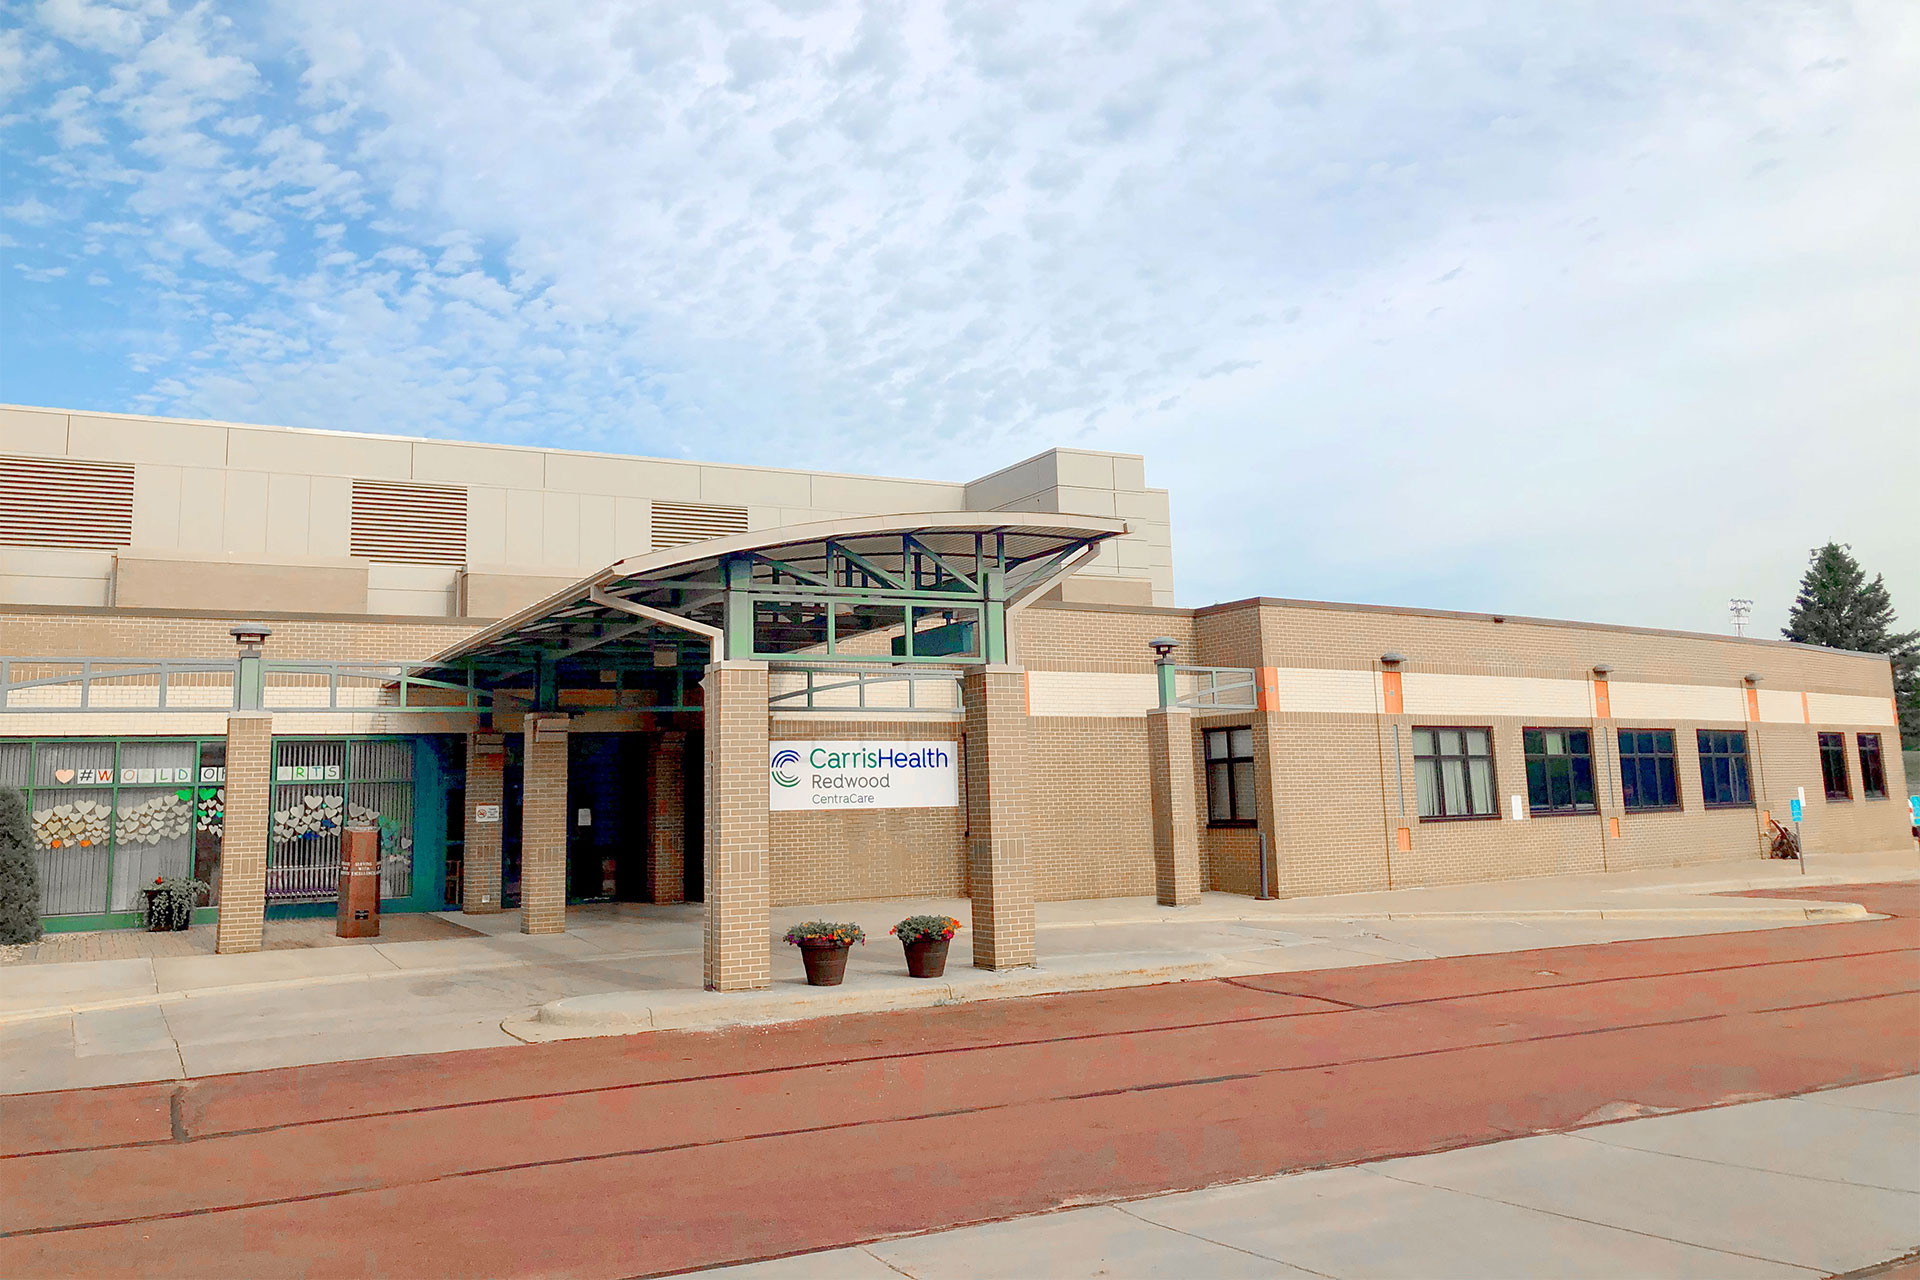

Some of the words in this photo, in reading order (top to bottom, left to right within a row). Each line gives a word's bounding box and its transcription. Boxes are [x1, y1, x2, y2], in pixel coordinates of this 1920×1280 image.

[810, 748, 948, 768] CarrisHealth
[812, 773, 890, 788] Redwood
[812, 793, 875, 804] CentraCare
